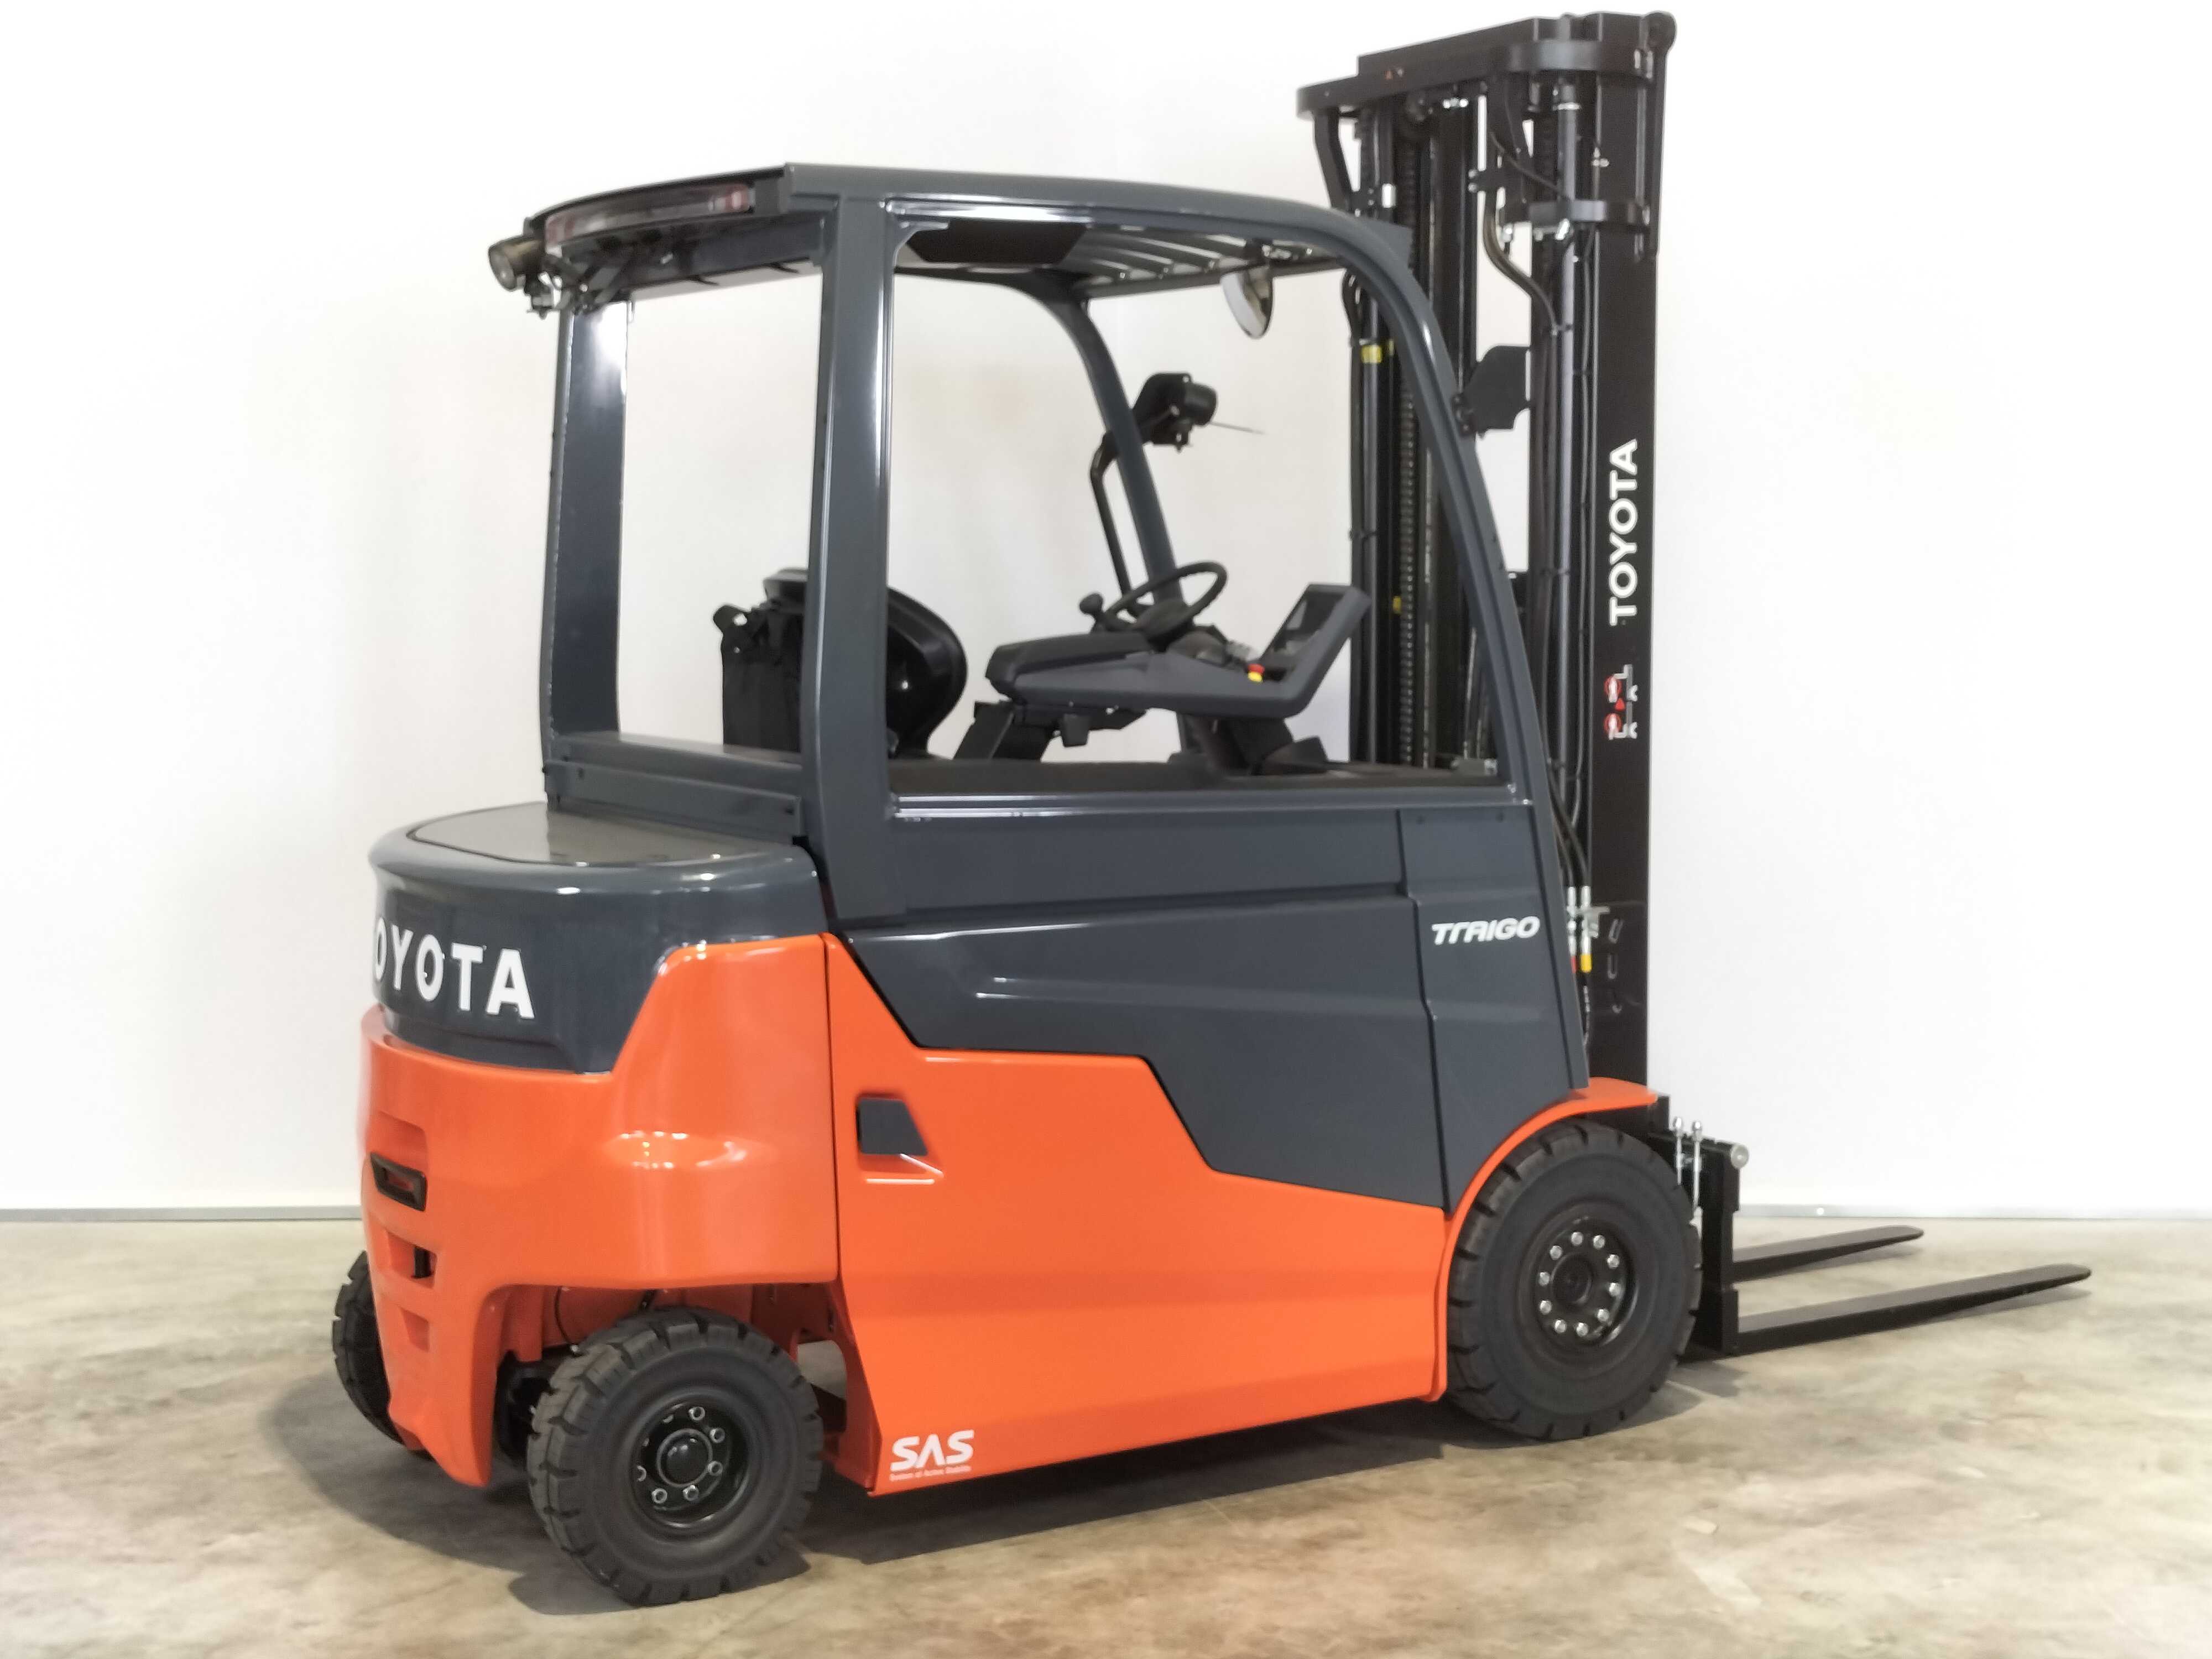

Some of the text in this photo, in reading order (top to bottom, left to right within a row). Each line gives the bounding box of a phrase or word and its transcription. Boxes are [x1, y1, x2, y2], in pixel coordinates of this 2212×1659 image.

[1609, 439, 1637, 626] TOYOTA
[374, 917, 535, 1020] OYOTA
[890, 1429, 974, 1472] SAS
